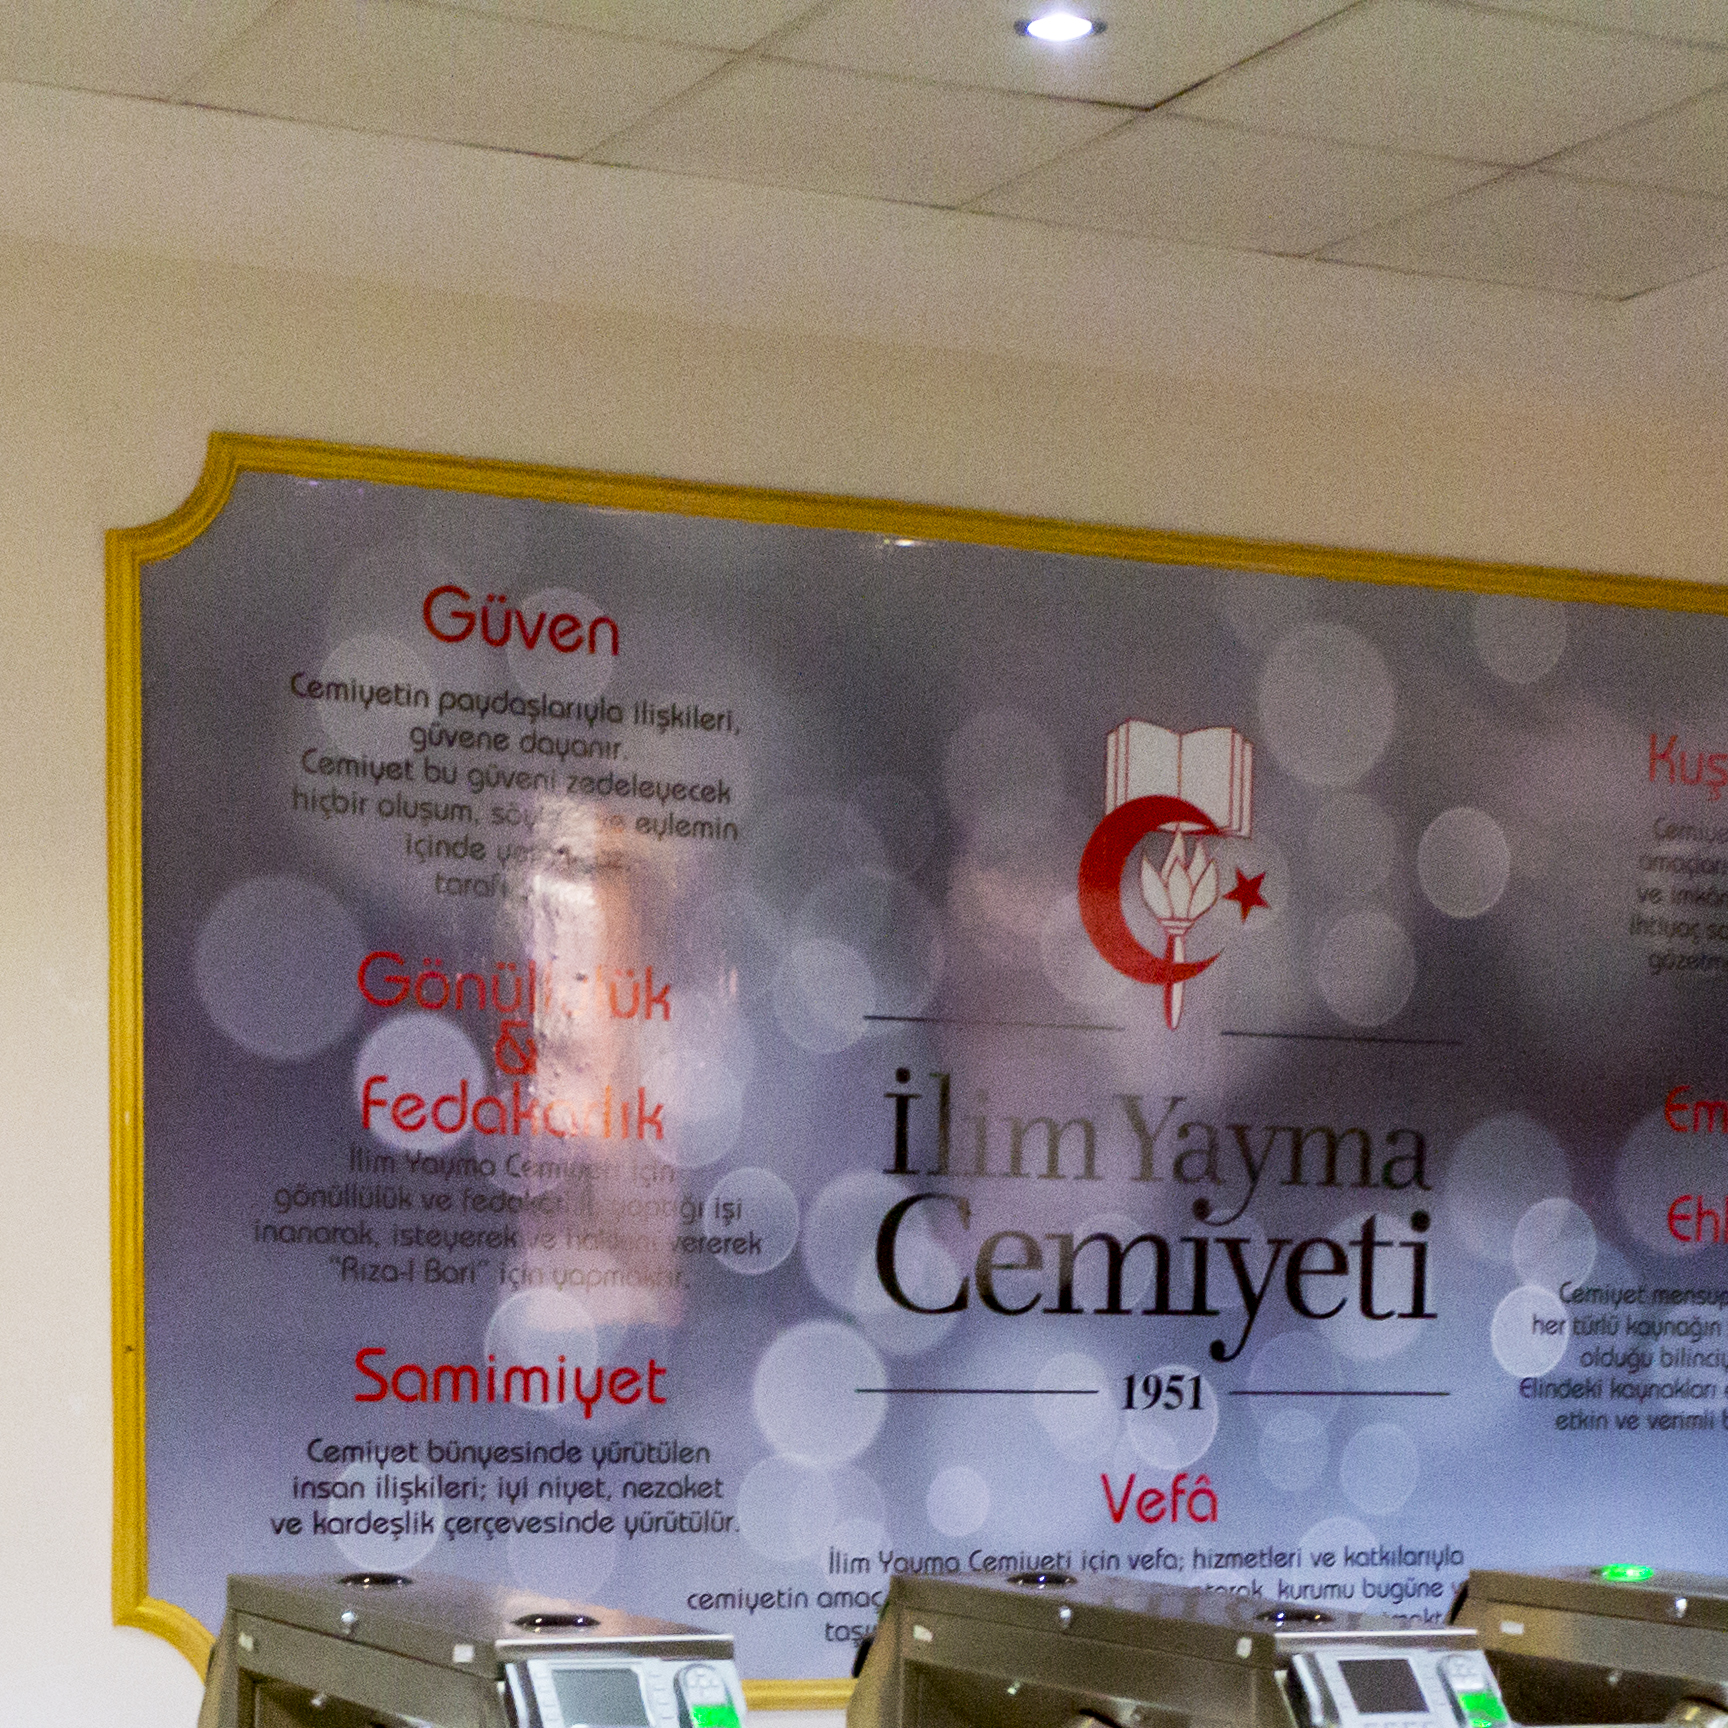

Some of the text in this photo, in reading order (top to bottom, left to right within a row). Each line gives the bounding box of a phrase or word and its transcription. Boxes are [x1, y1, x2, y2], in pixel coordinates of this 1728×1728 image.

[423, 585, 620, 656] Güven
[290, 672, 429, 710] Cemiyetin
[438, 688, 623, 728] paydaşlarıyla
[409, 720, 510, 754] güvene
[300, 748, 732, 806] Cemiyet bu güveni zedeleyecek
[291, 785, 368, 820] hiçbir
[635, 812, 739, 842] eylemin
[405, 833, 487, 864] içinde
[357, 950, 672, 1020] Gönülllük
[494, 1019, 537, 1076] &
[882, 1067, 1432, 1226] İlim Yayma
[273, 1182, 412, 1214] gönüllülük
[420, 1192, 452, 1211] ve
[715, 1196, 743, 1226] işi
[391, 1221, 518, 1255] isteyerek
[875, 1191, 1438, 1363] Cemiyeti
[1558, 1280, 1647, 1310] Cemiyet
[1531, 1312, 1567, 1335] her
[1625, 1314, 1722, 1344] kaynağın
[1579, 1345, 1654, 1374] olduğu
[354, 1347, 667, 1419] Samimiyet
[1121, 1374, 1205, 1411] 1951
[1554, 1408, 1608, 1432] etkin
[1615, 1413, 1640, 1431] ve
[306, 1436, 711, 1471] Cemiyet bünyesinde yürütülen
[292, 1475, 365, 1500] insan
[497, 1475, 529, 1506] iyi
[538, 1476, 613, 1505] niyet,
[622, 1475, 725, 1502] nezaket
[1100, 1472, 1219, 1526] Vefâ
[271, 1509, 740, 1541] ve kardeşlik çerçevesinde yürütülür.
[828, 1546, 871, 1575] İlim
[968, 1548, 1072, 1574] Cemiyeti
[1080, 1549, 1121, 1574] için
[1191, 1546, 1303, 1570] hizmetleri
[1310, 1550, 1336, 1569] ve
[1343, 1544, 1466, 1573] katkılarıyla
[686, 1586, 809, 1616] cemiyetin
[1277, 1578, 1355, 1601] kurumu
[1361, 1576, 1445, 1605] bugüne
